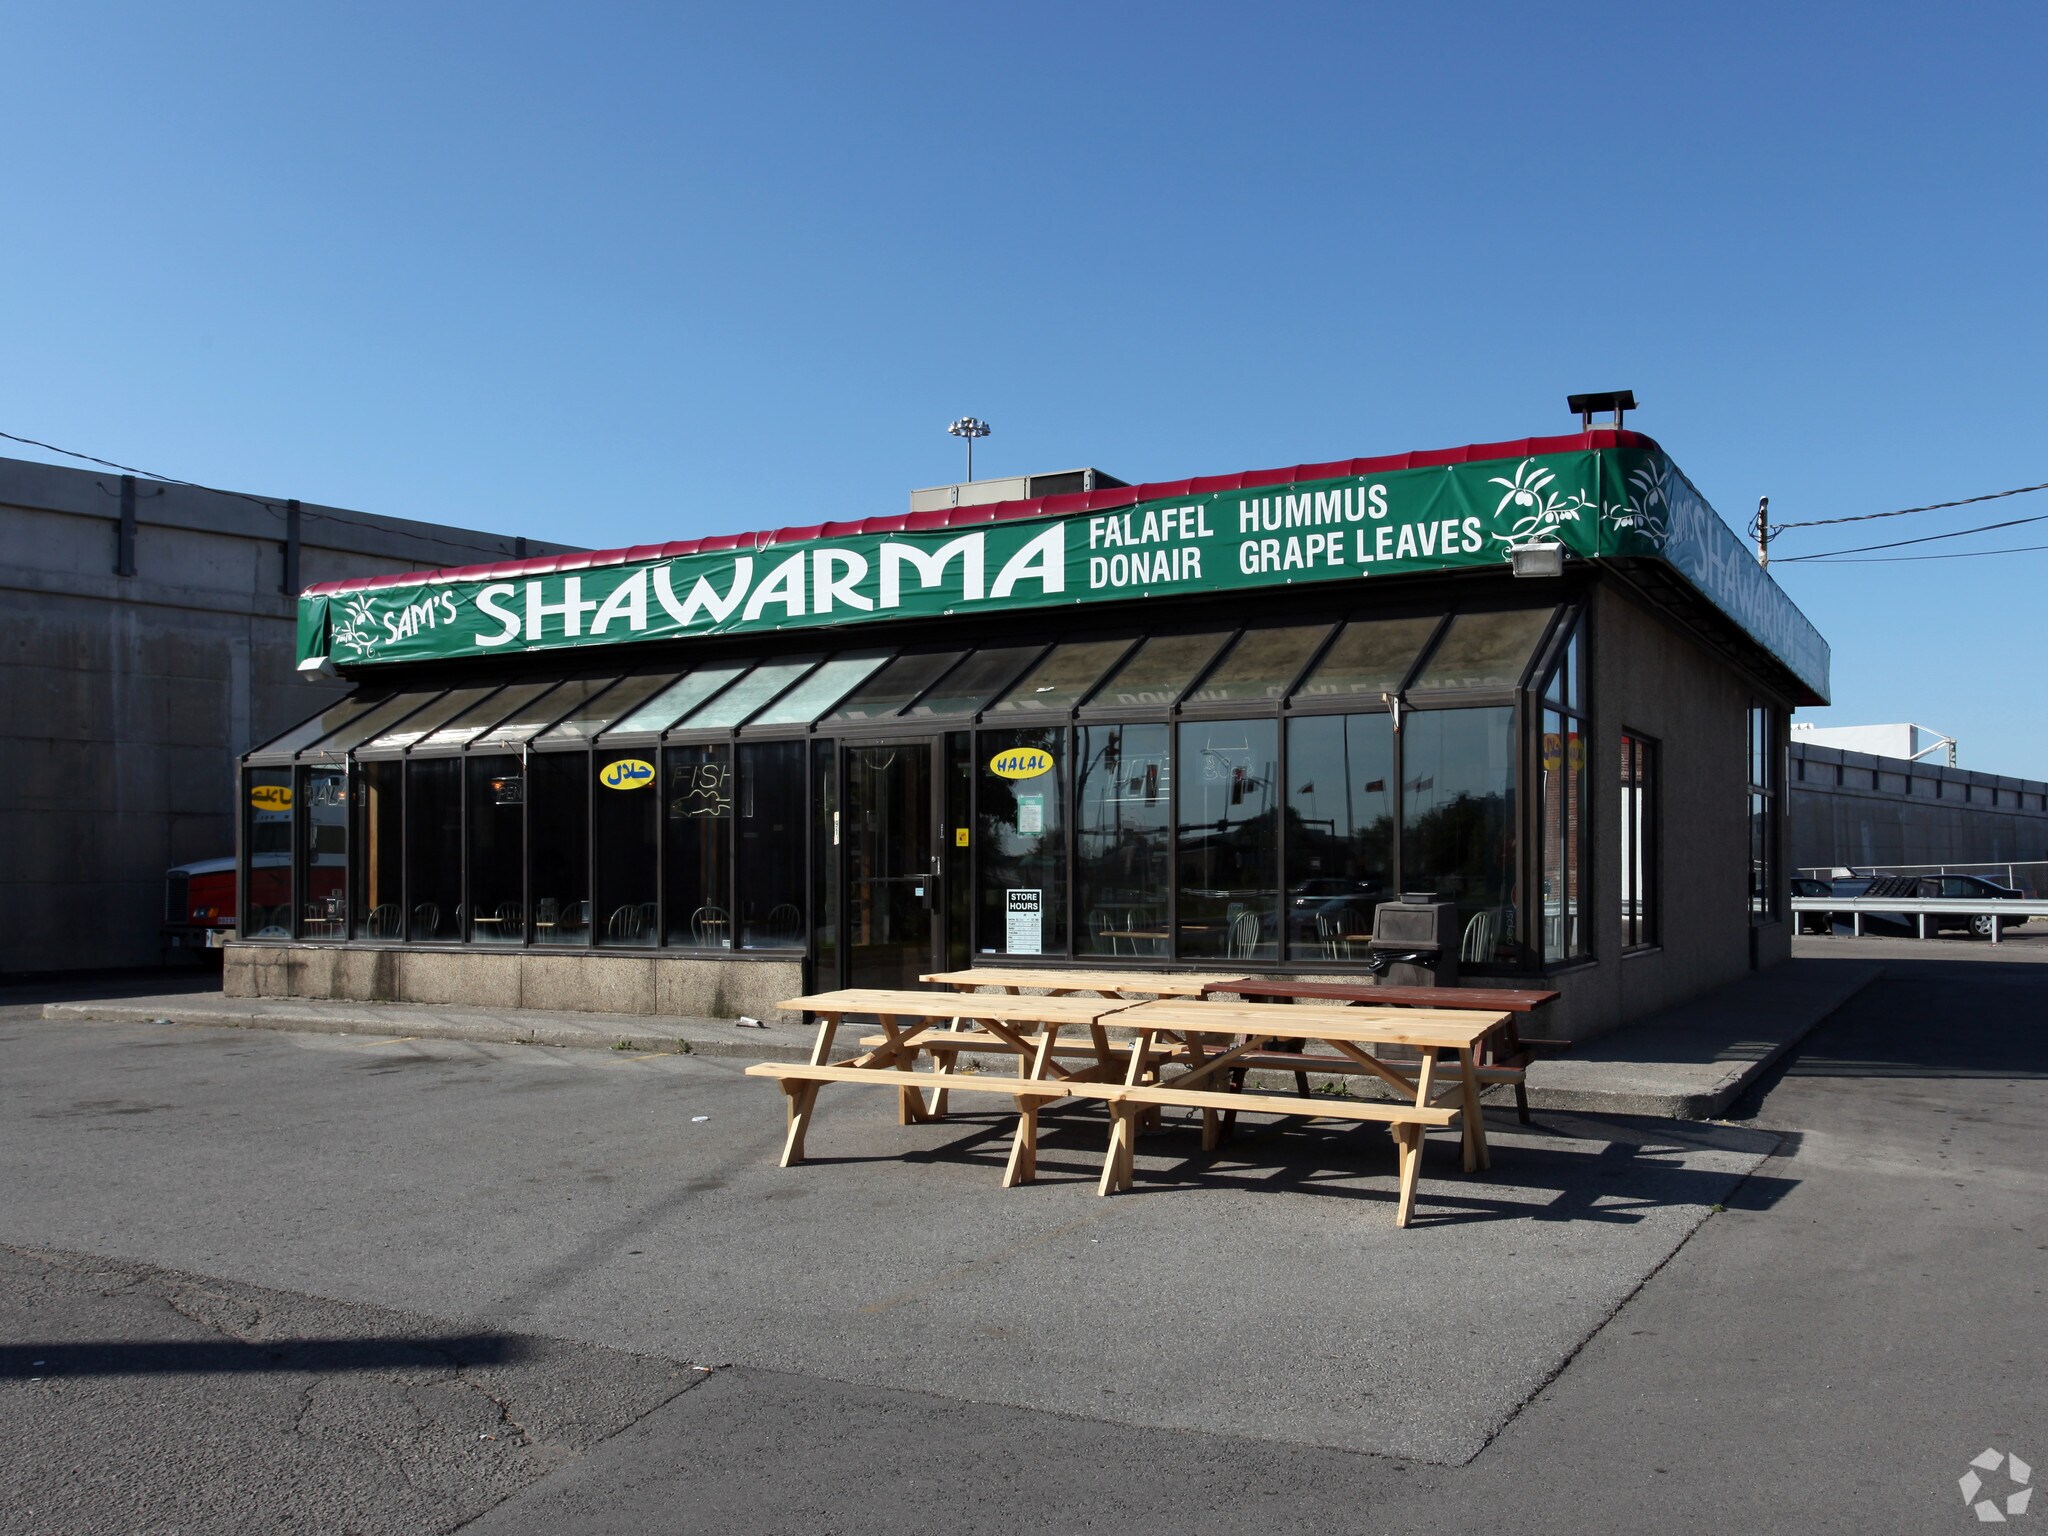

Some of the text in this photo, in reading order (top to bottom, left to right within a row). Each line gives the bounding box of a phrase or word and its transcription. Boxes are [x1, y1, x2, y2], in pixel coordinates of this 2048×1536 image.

[1089, 506, 1214, 550] FALAFEL
[1239, 484, 1388, 533] HUMMUS
[1239, 516, 1483, 575] GRAPE LEAVES
[383, 521, 1065, 648] SAM'S SHAWARMA
[1090, 547, 1202, 589] DONAIR
[1693, 505, 1797, 661] SHAWARMA
[607, 761, 652, 786] حلال
[997, 755, 1046, 772] HALAL
[1010, 902, 1038, 910] HOURS
[1011, 893, 1037, 901] STORE
